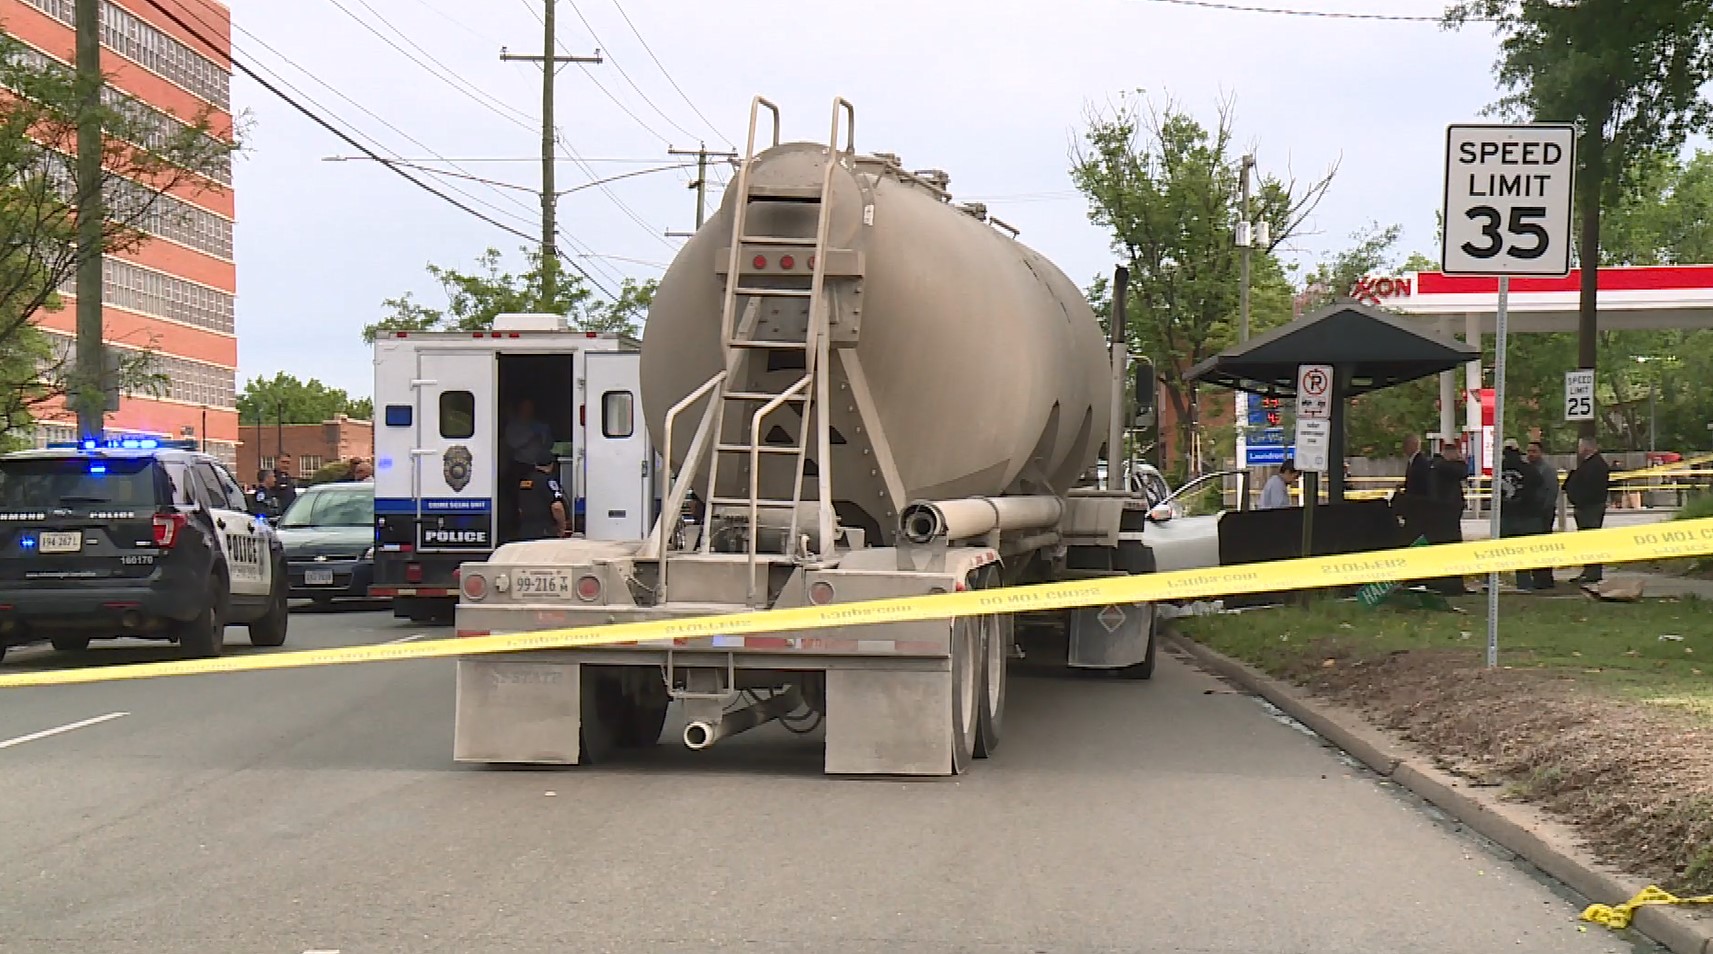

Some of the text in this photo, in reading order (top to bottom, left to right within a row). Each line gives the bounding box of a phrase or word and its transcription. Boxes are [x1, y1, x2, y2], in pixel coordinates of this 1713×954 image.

[1459, 142, 1562, 165] SPEED
[1469, 173, 1551, 197] LIMIT
[1460, 205, 1550, 259] 35
[1350, 275, 1411, 304] XXON
[1568, 376, 1591, 385] SPEED
[1570, 385, 1588, 395] LIMIT
[1568, 397, 1590, 415] 25
[89, 511, 135, 519] POLICE
[425, 530, 487, 542] POLICE
[226, 534, 257, 564] POLICE
[121, 556, 153, 564] 160170
[517, 576, 556, 592] 99-216
